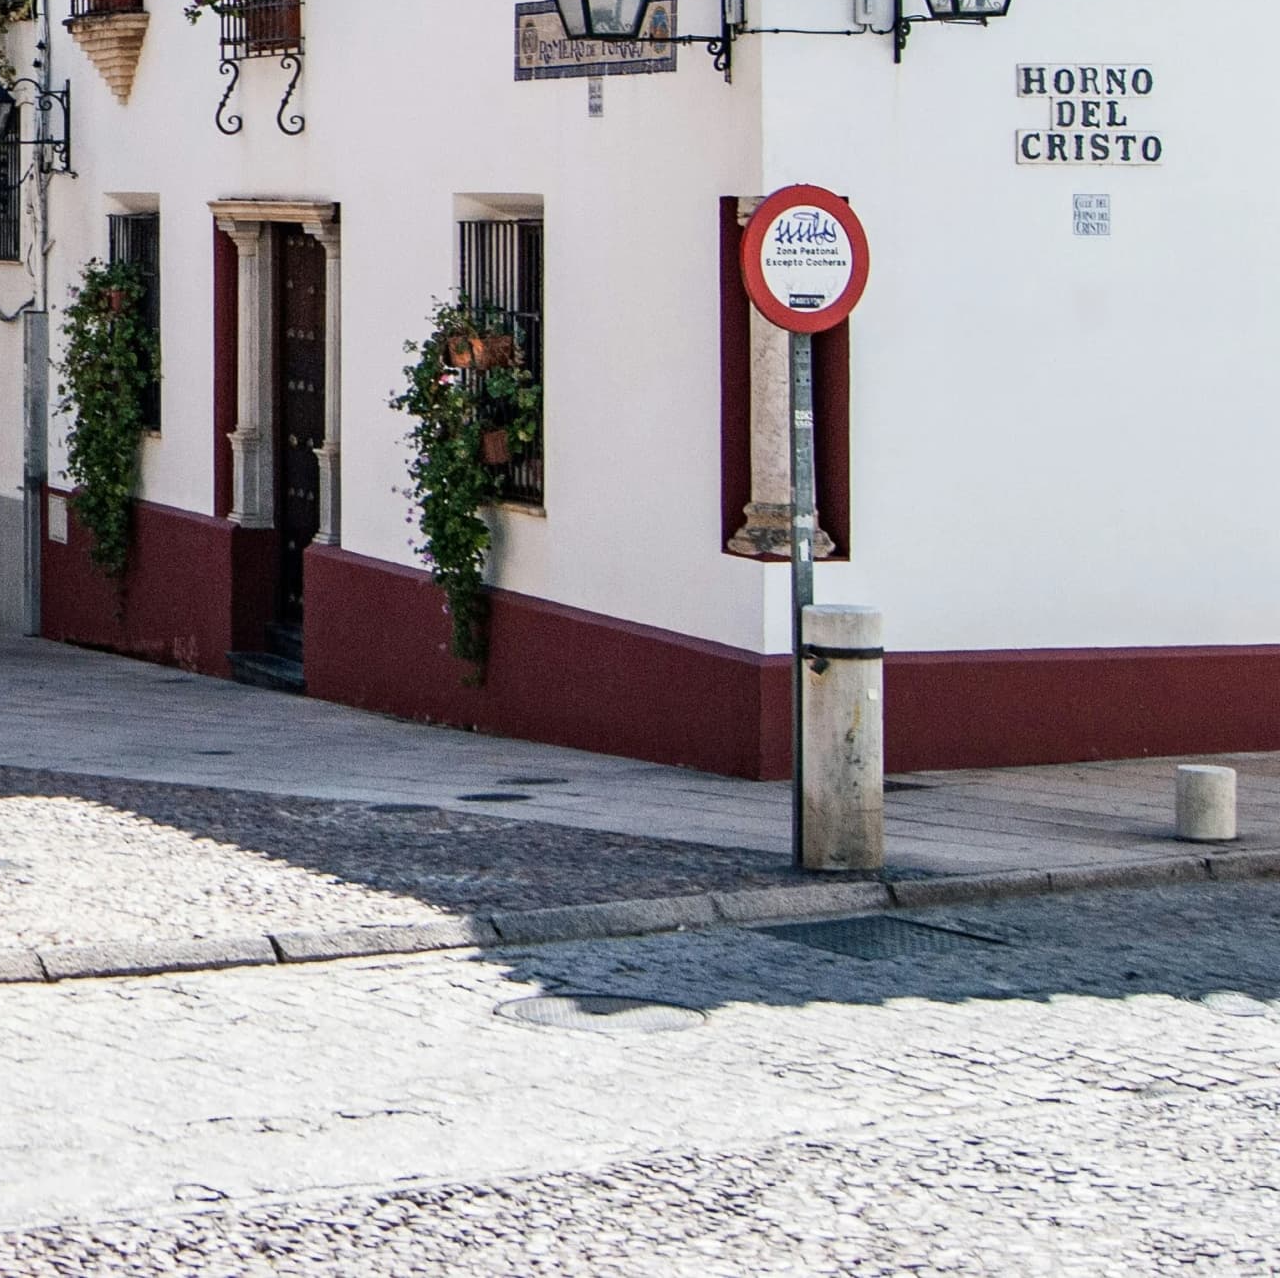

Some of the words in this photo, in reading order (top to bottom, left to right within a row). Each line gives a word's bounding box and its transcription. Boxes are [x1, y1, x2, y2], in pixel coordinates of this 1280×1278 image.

[539, 39, 584, 63] ROMERO
[1022, 67, 1153, 95] HORNO
[1056, 100, 1127, 128] DEL
[1021, 133, 1162, 161] CRISTO
[766, 258, 803, 268] Excepto
[806, 258, 847, 267] Cocheras
[776, 247, 797, 255] Zona
[800, 246, 839, 255] Peatonal
